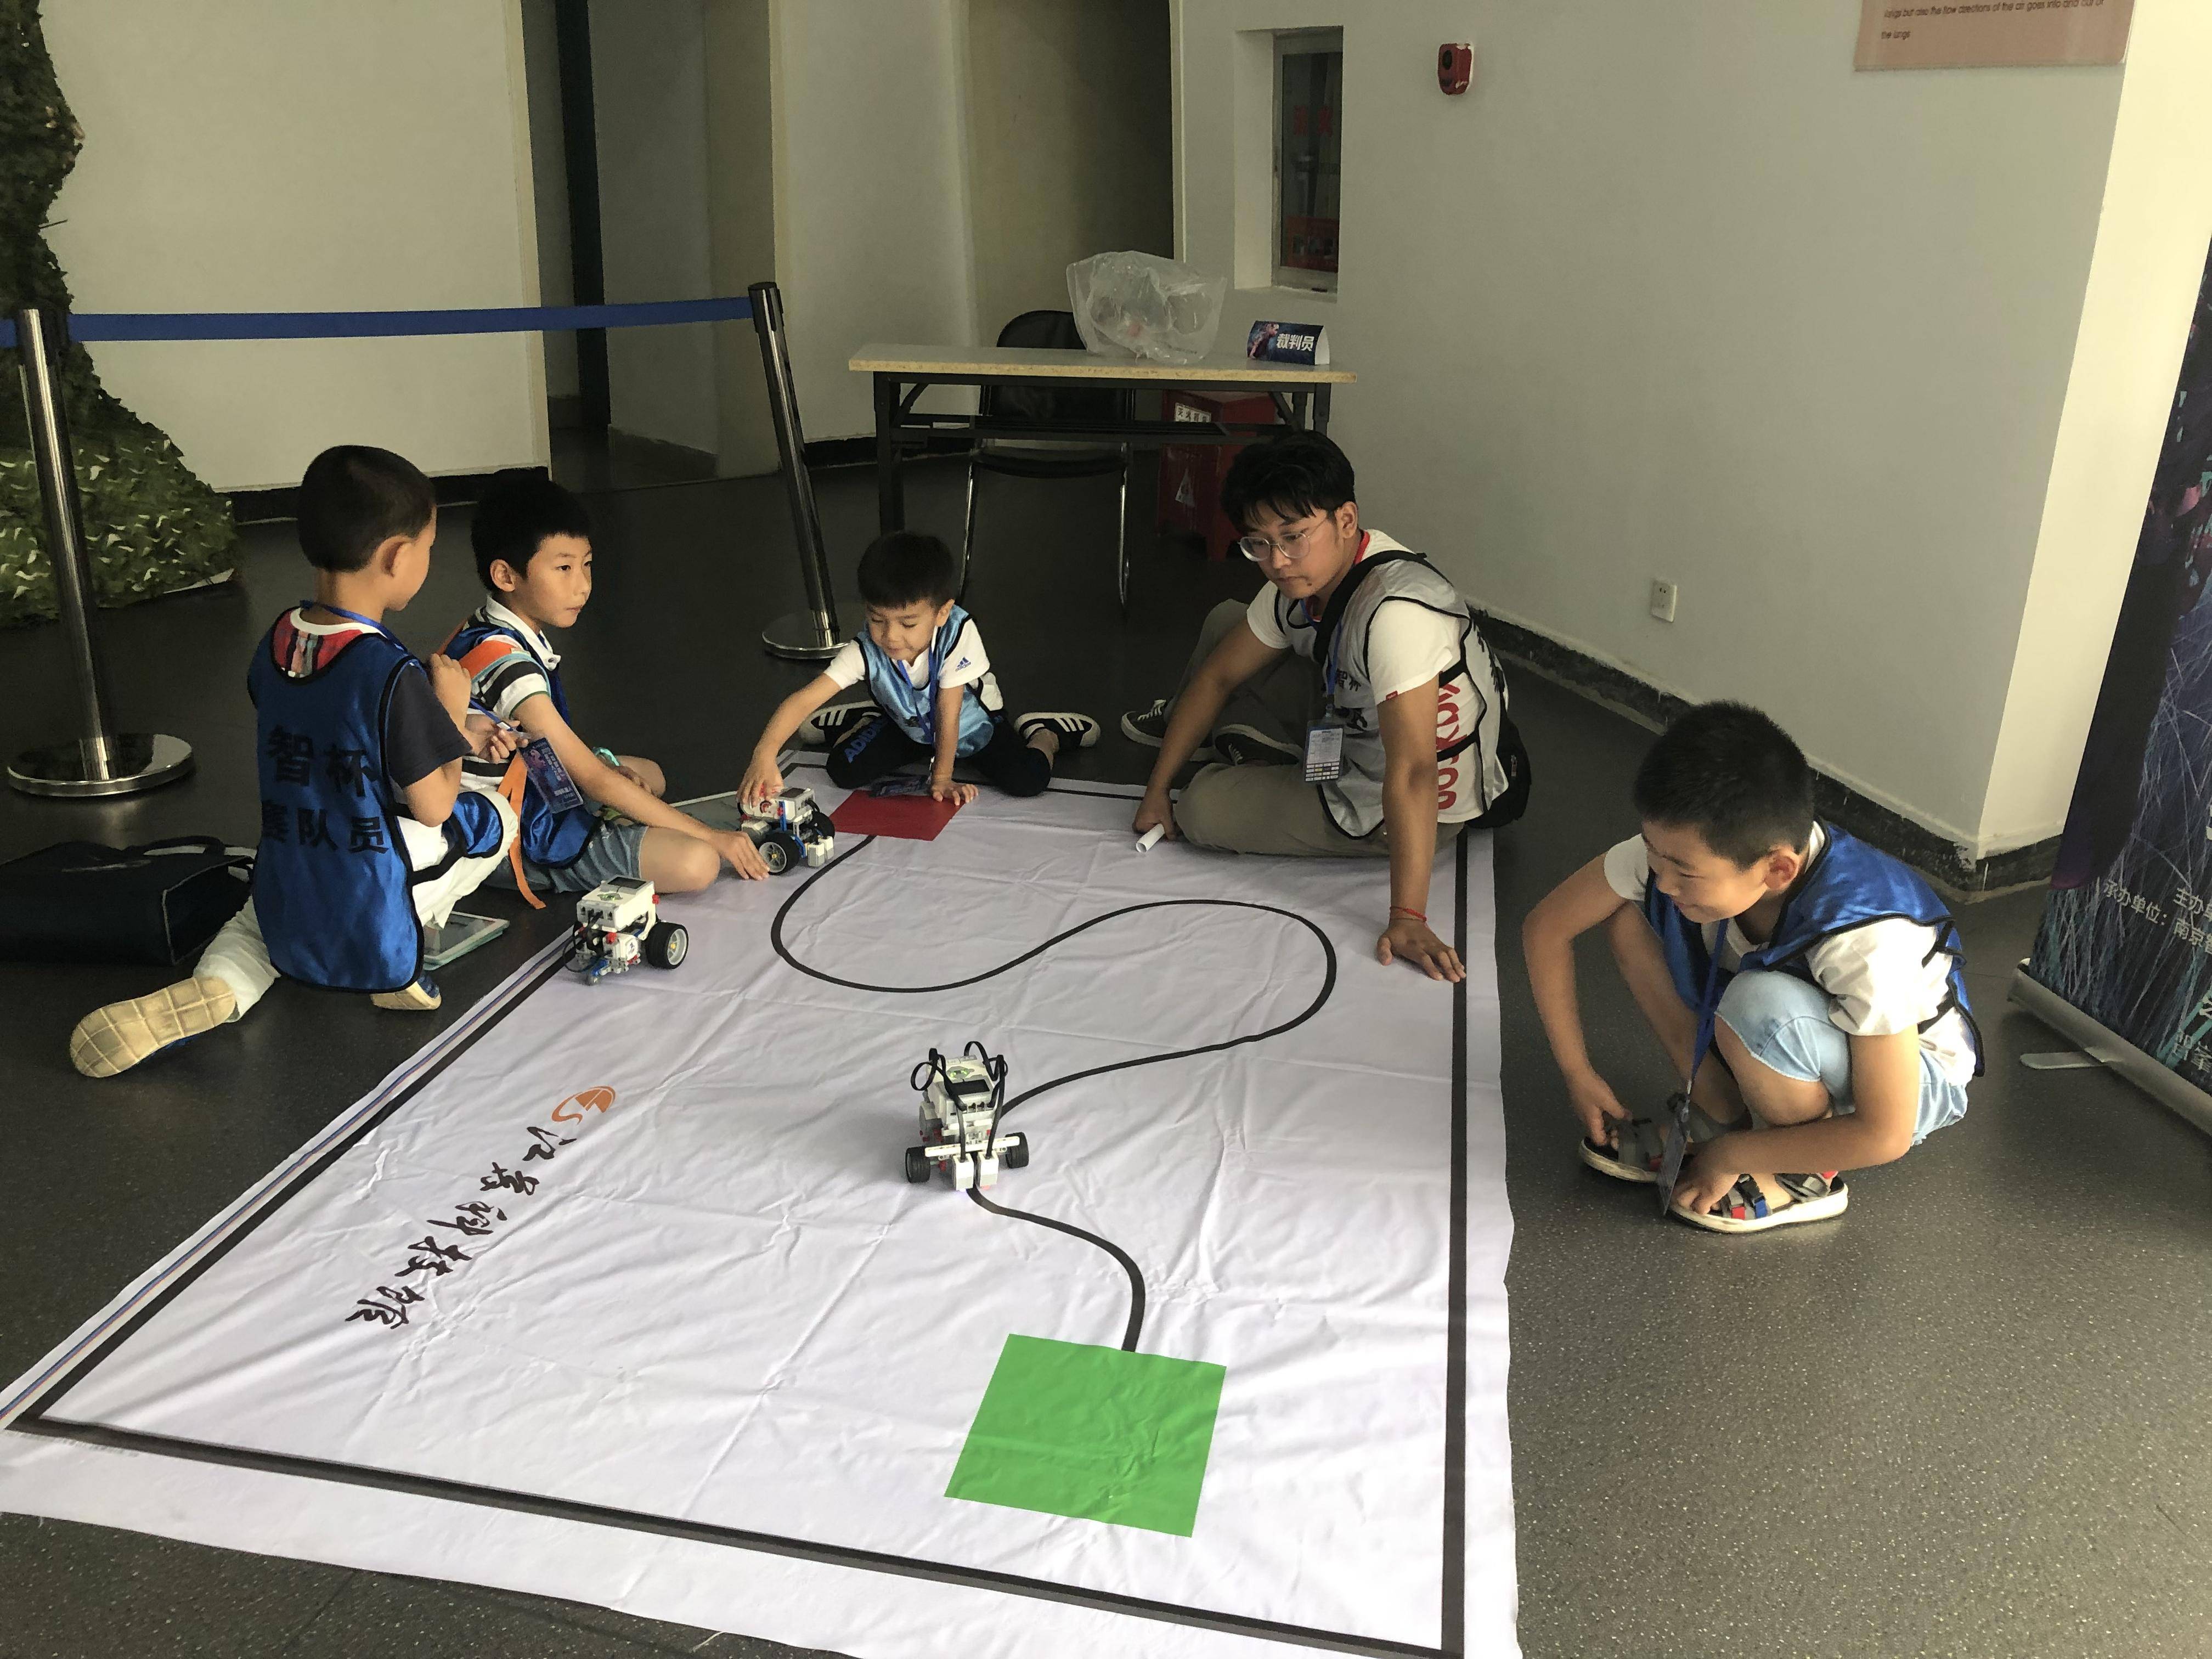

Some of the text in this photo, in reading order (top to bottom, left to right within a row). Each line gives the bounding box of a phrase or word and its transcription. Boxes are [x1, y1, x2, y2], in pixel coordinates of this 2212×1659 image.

[1992, 2, 2000, 12] of
[2002, 2, 2013, 12] the
[2027, 2, 2045, 12] goes
[2046, 1, 2061, 9] into
[1276, 333, 1314, 351] 裁判员
[345, 1126, 577, 1329] 江苏科技馆
